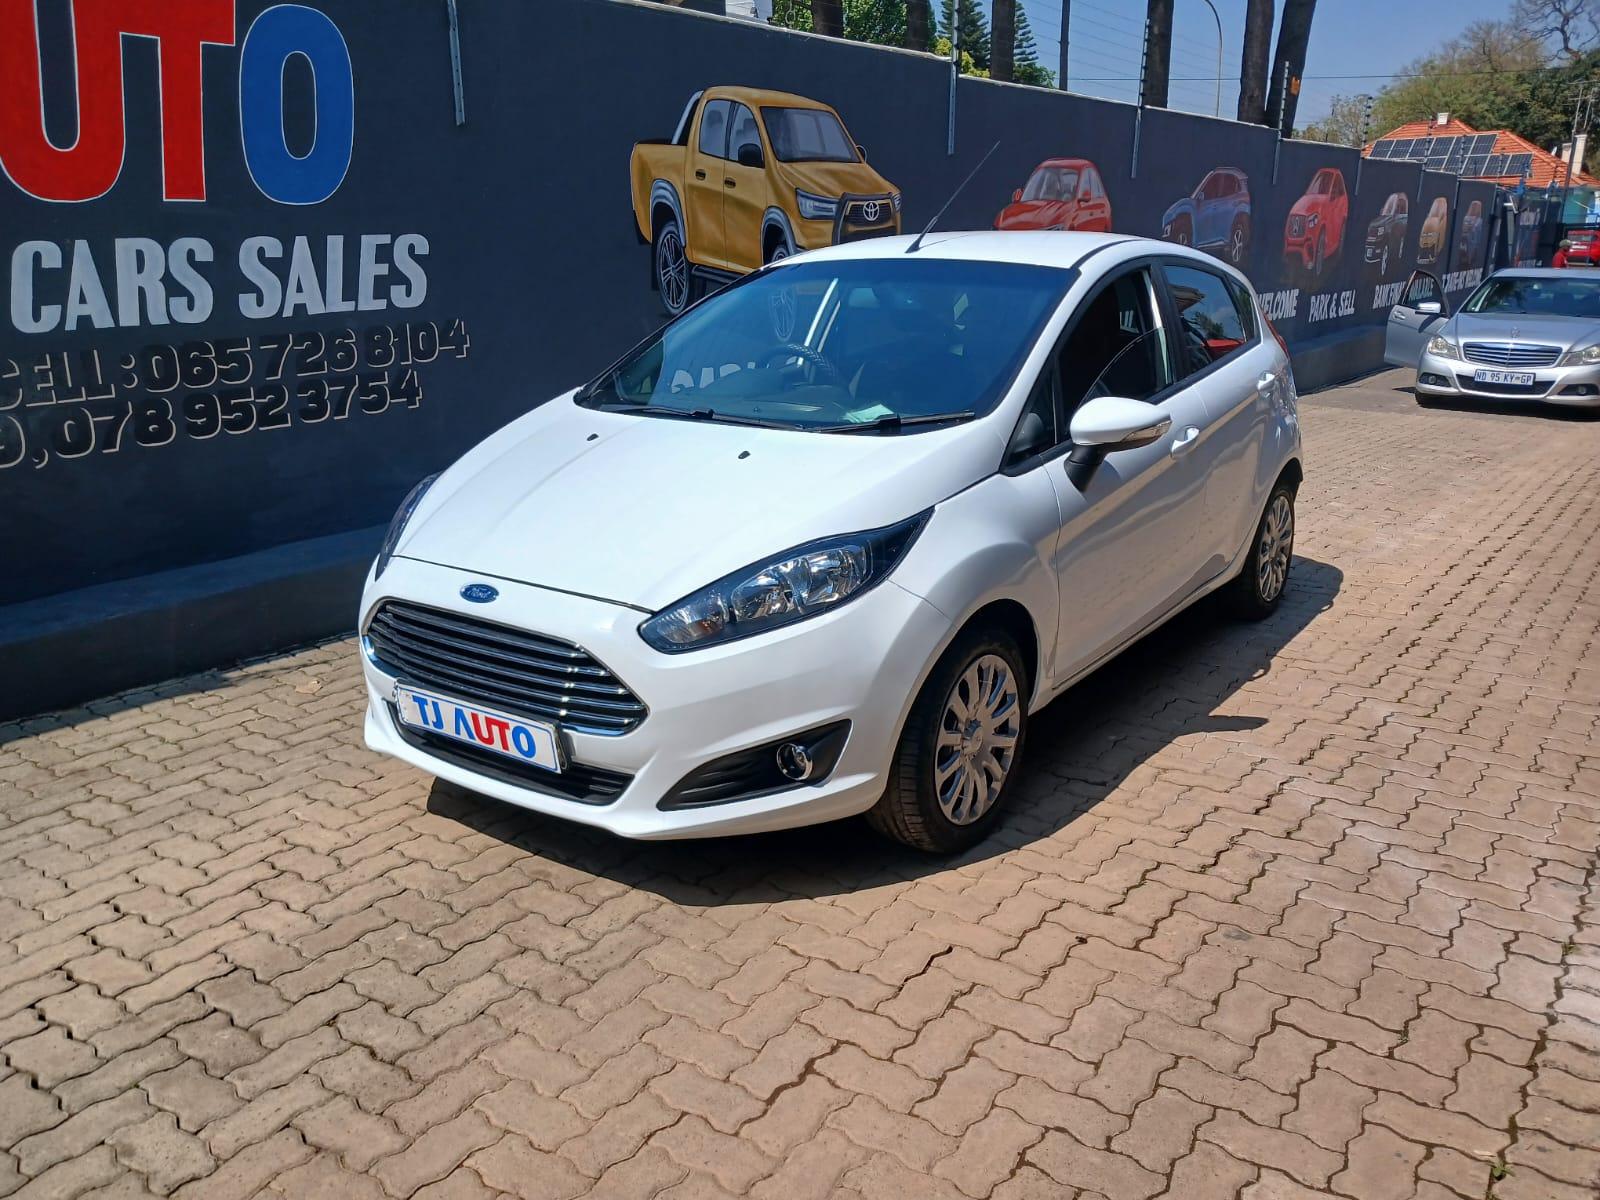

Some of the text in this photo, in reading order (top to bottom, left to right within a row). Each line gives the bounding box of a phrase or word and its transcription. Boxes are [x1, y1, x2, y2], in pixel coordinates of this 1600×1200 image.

[10, 233, 430, 334] CARS SALES
[1308, 289, 1356, 323] PARK & SELL
[259, 328, 357, 380] 726
[364, 317, 470, 369] 8104
[184, 380, 292, 440] 952
[297, 370, 423, 423] 3754
[412, 694, 537, 759] TJ AUTO
